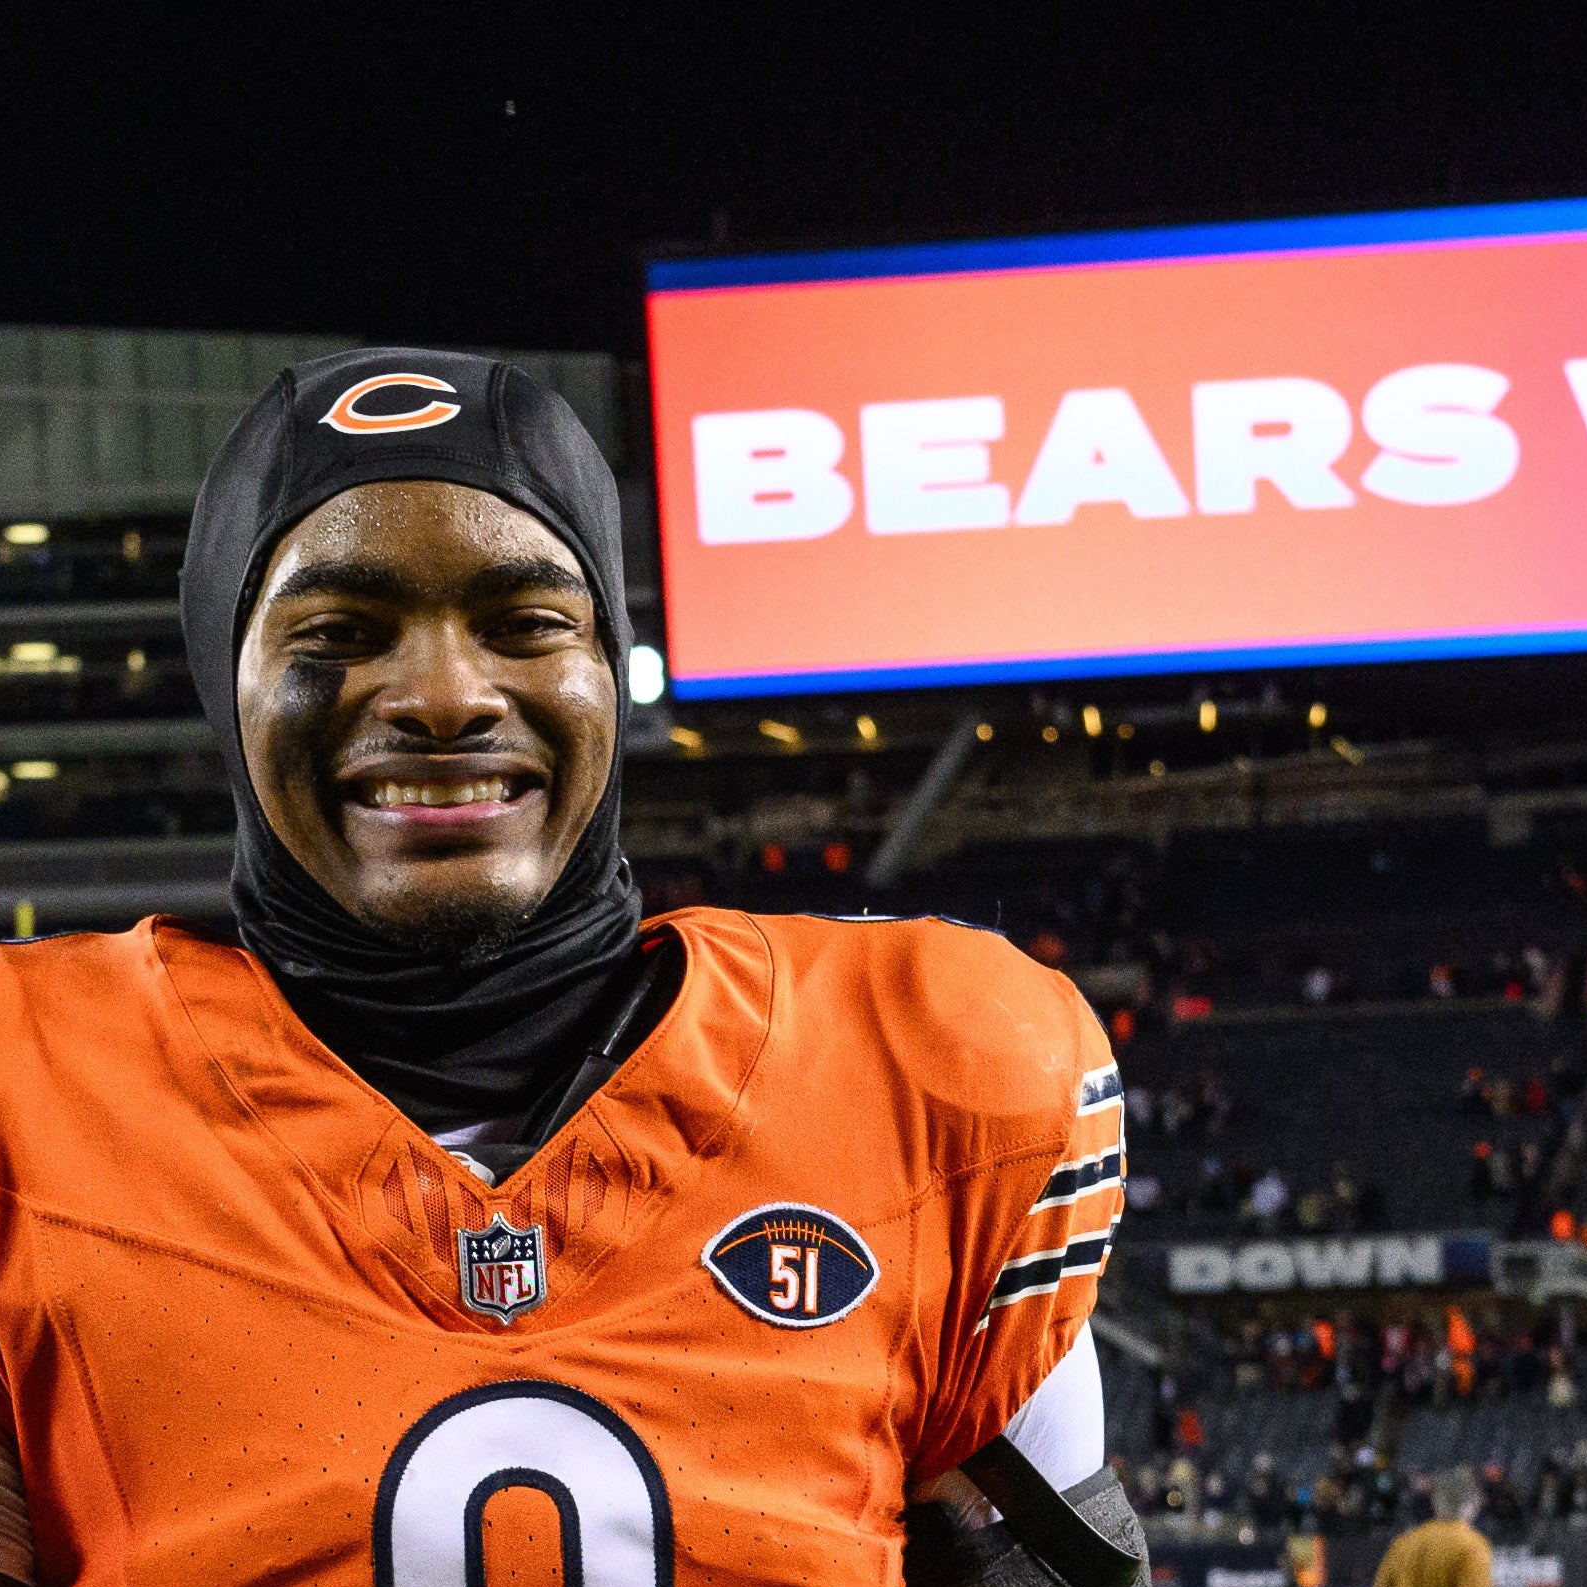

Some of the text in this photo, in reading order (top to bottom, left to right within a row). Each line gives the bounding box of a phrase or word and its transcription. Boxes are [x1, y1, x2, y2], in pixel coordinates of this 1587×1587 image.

[691, 360, 1521, 546] BEARS
[474, 1263, 532, 1305] NFL
[768, 1243, 820, 1315] 51
[1167, 1235, 1443, 1294] DOWN
